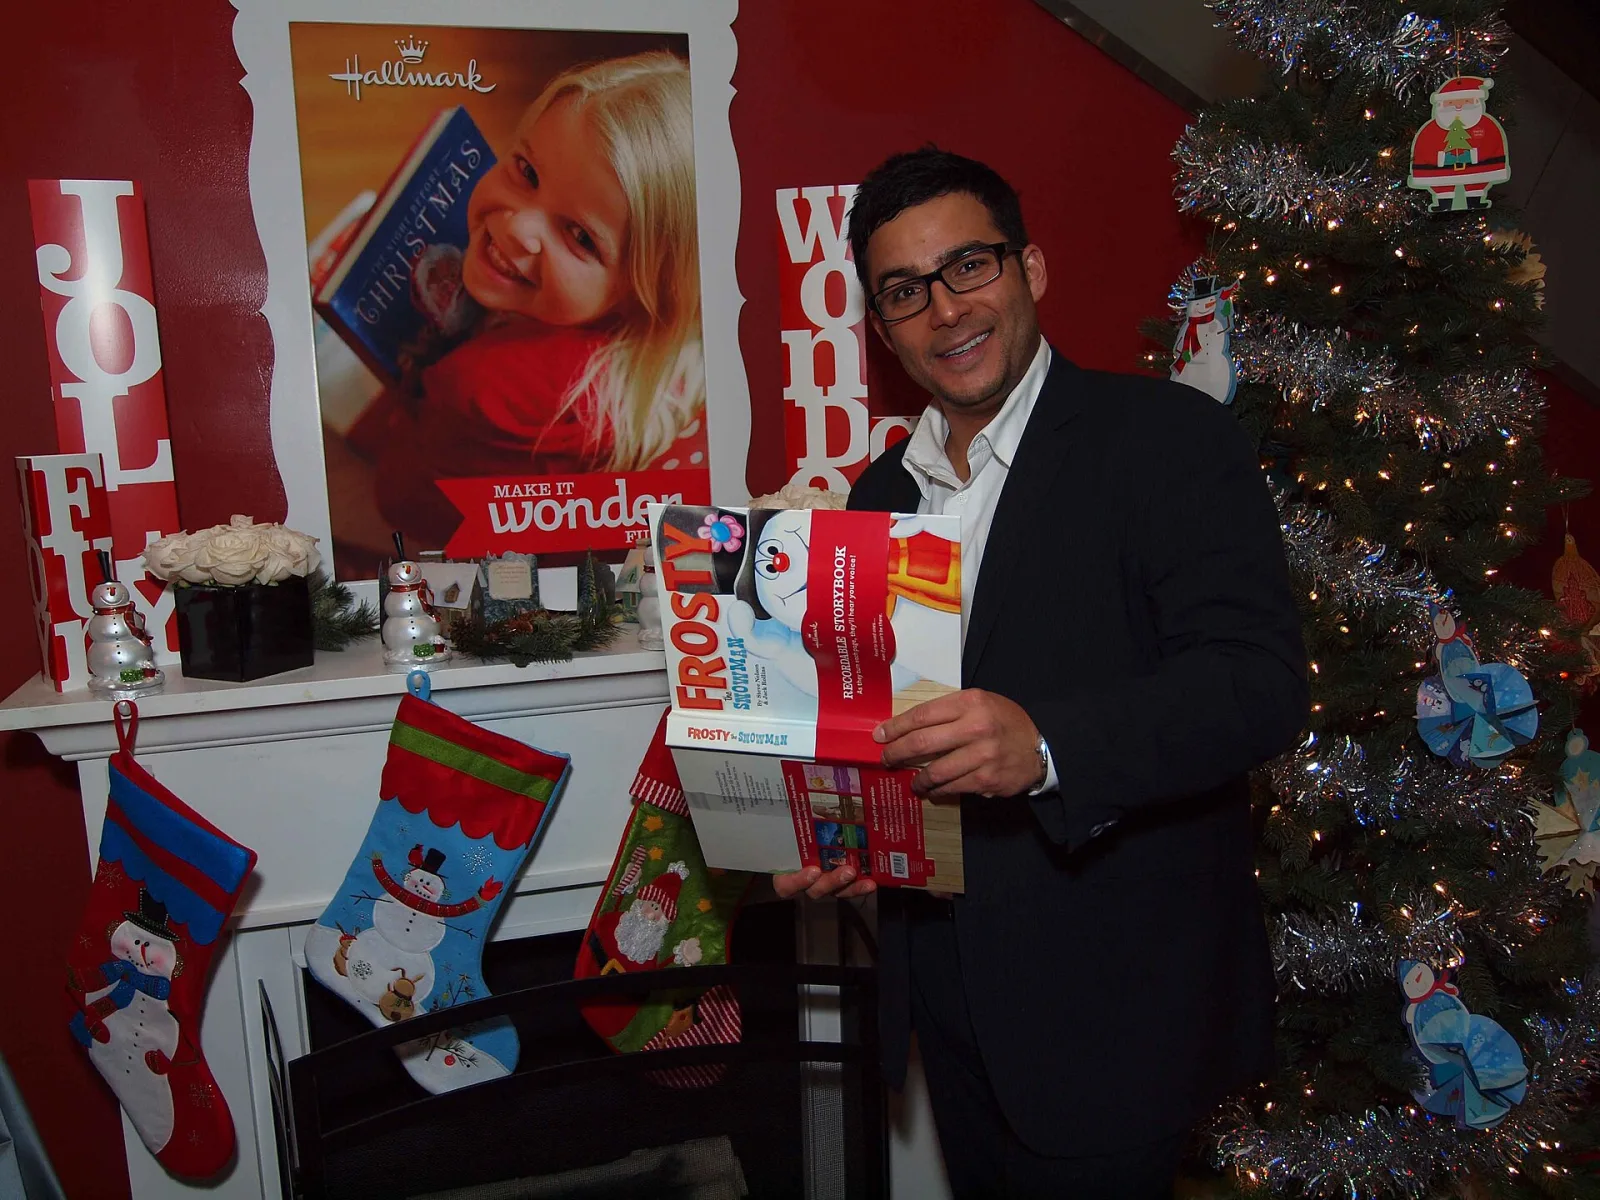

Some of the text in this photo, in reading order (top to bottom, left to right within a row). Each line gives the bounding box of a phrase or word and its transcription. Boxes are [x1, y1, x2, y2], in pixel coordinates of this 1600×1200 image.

[329, 54, 497, 101] Hallmark
[355, 138, 482, 324] CHRISTMAS
[493, 481, 575, 499] MAKE IT
[848, 555, 856, 579] voice!
[848, 581, 856, 599] your
[661, 522, 728, 711] FROSTY
[834, 546, 854, 699] RECORDABLE STORYBOOK
[809, 621, 823, 648] Hallmark
[849, 618, 857, 637] they'll
[851, 638, 860, 652] page,
[727, 637, 751, 710] SNOWMAN
[723, 692, 732, 701] the
[857, 687, 863, 695] As
[687, 727, 731, 742] FROSTY
[738, 731, 788, 746] SNOWMAN
